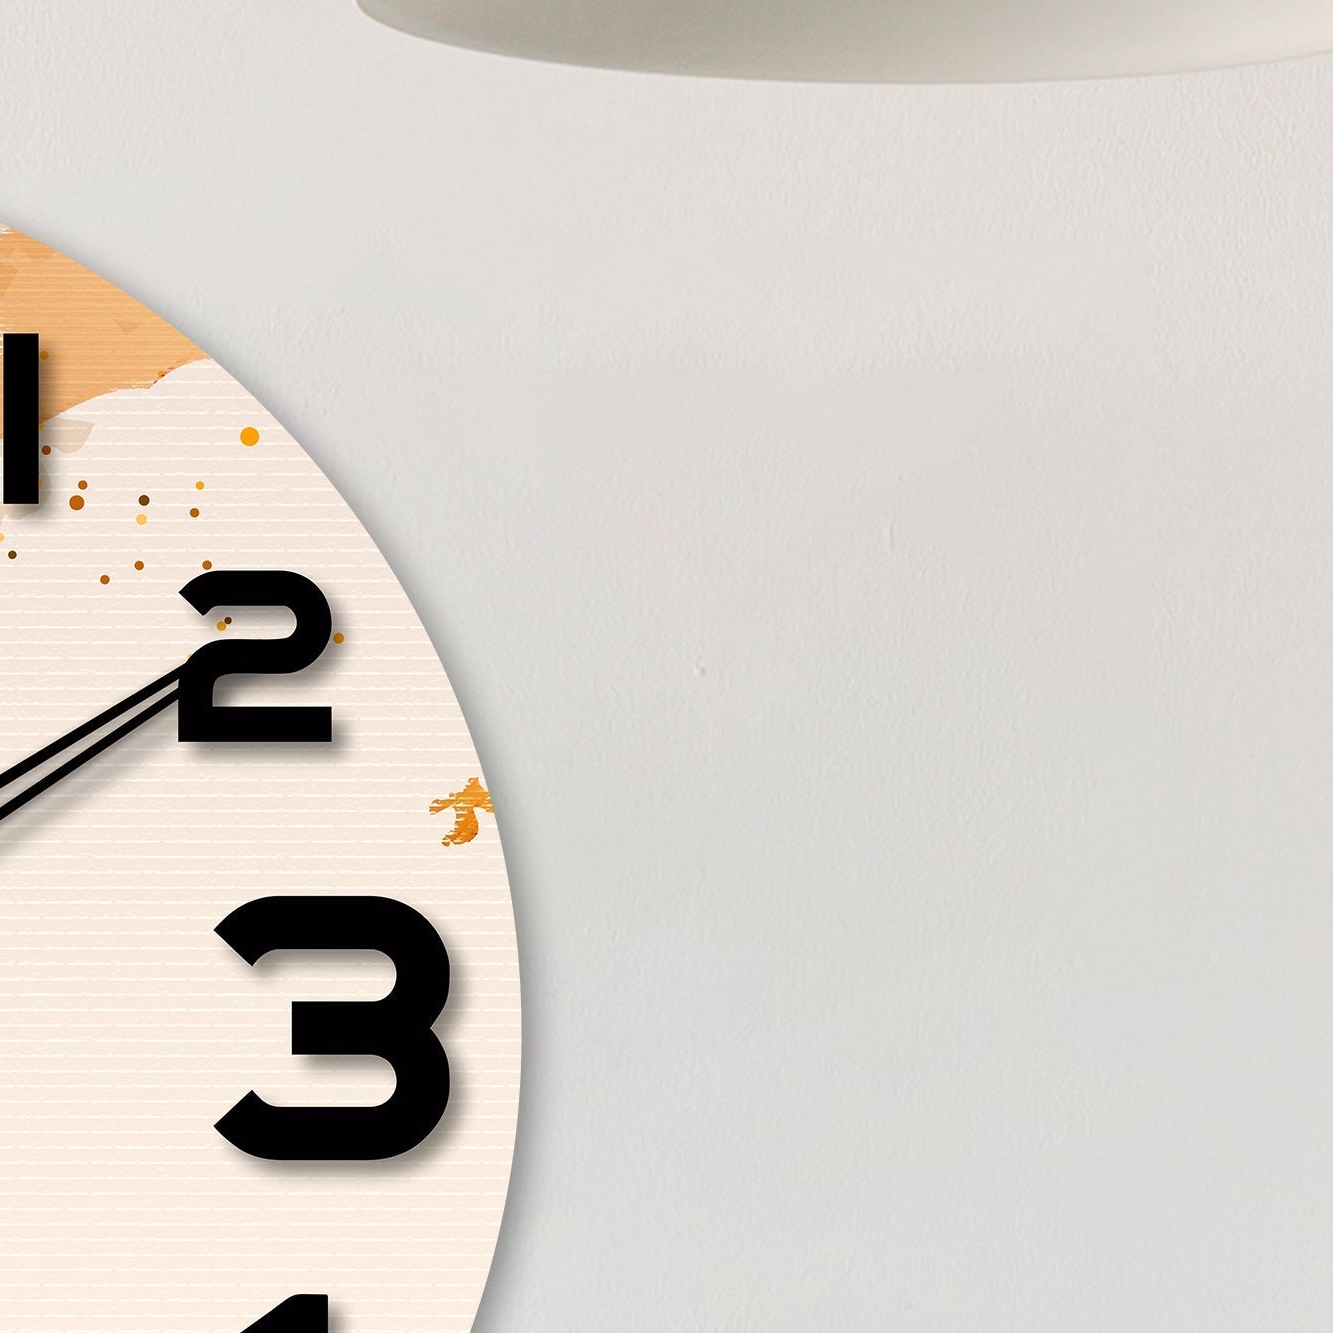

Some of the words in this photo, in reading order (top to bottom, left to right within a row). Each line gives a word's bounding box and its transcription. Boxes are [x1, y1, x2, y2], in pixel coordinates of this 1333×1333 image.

[4, 334, 40, 504] 1
[178, 571, 332, 742] 2
[214, 896, 450, 1160] 3
